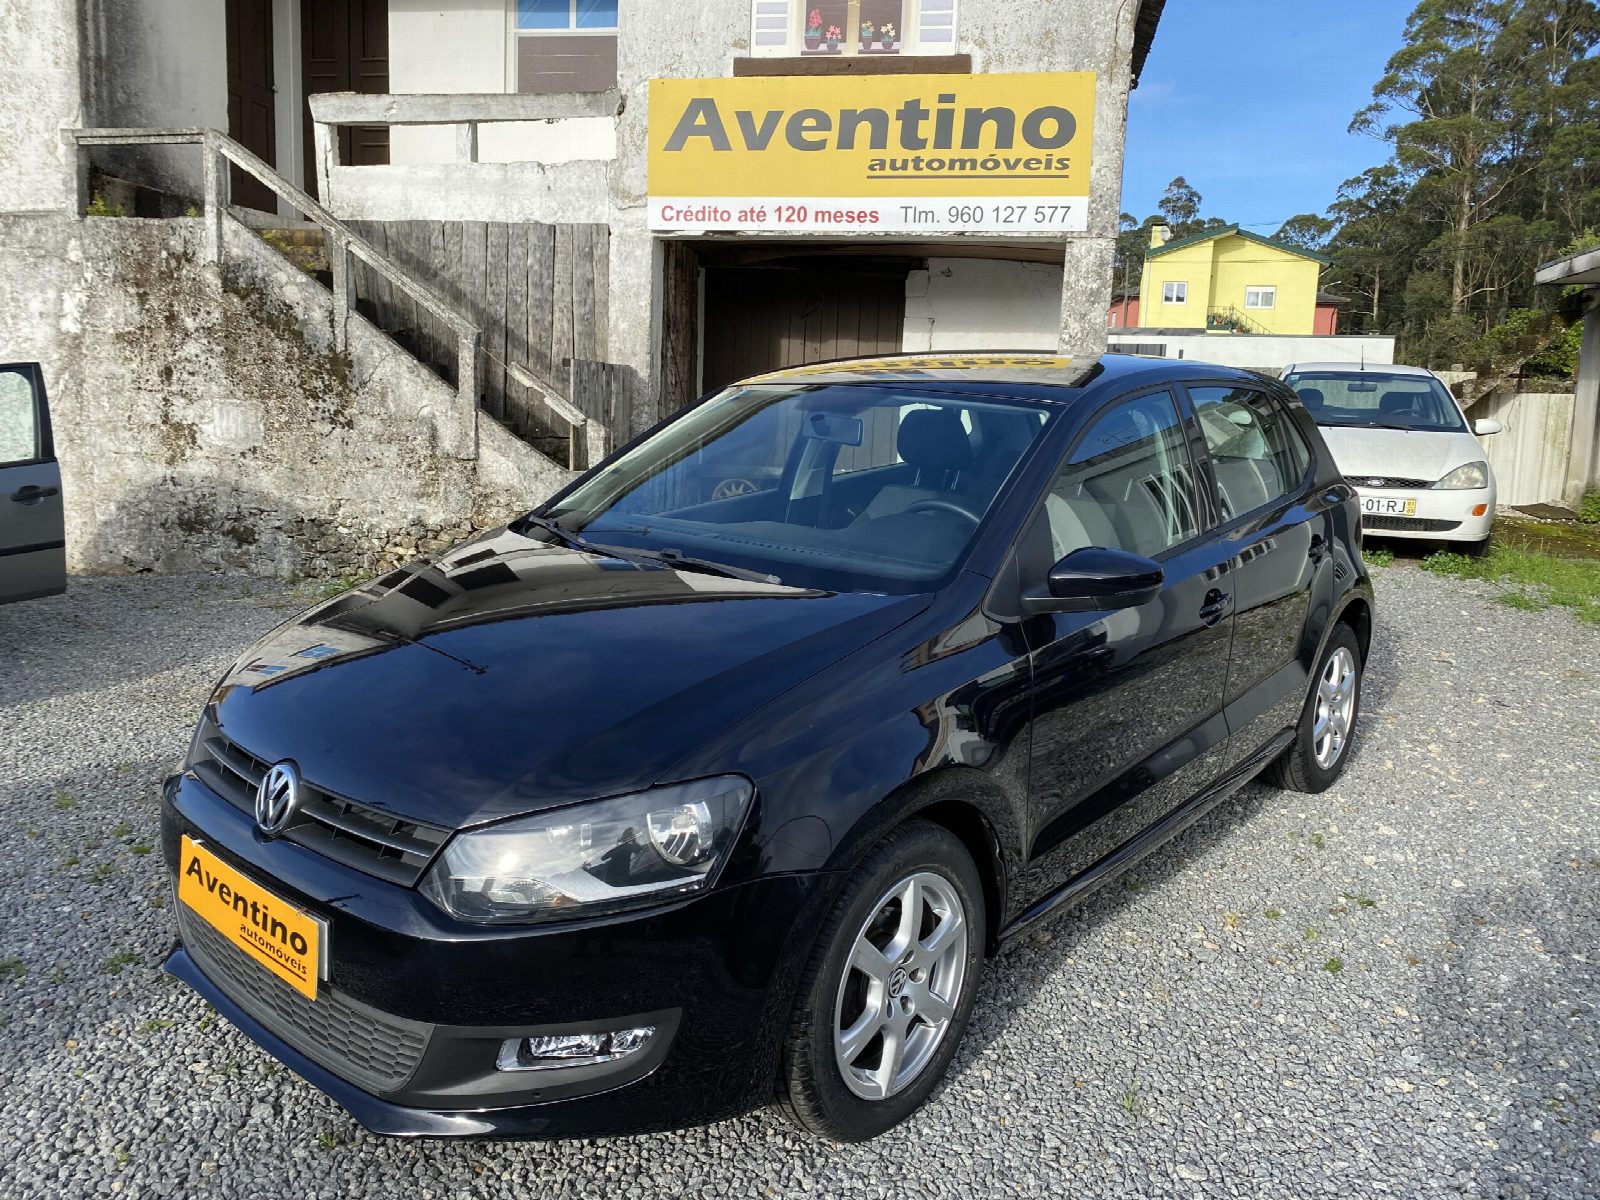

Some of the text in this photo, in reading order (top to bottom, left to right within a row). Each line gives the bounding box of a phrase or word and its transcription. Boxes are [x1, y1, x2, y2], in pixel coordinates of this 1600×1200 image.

[662, 93, 1077, 152] Aventino
[868, 153, 1071, 172] automóveis
[661, 205, 1072, 224] Crédito até 120 meses Tlm. 960 127 577
[186, 856, 308, 956] Aventino
[240, 923, 308, 975] automóveis
